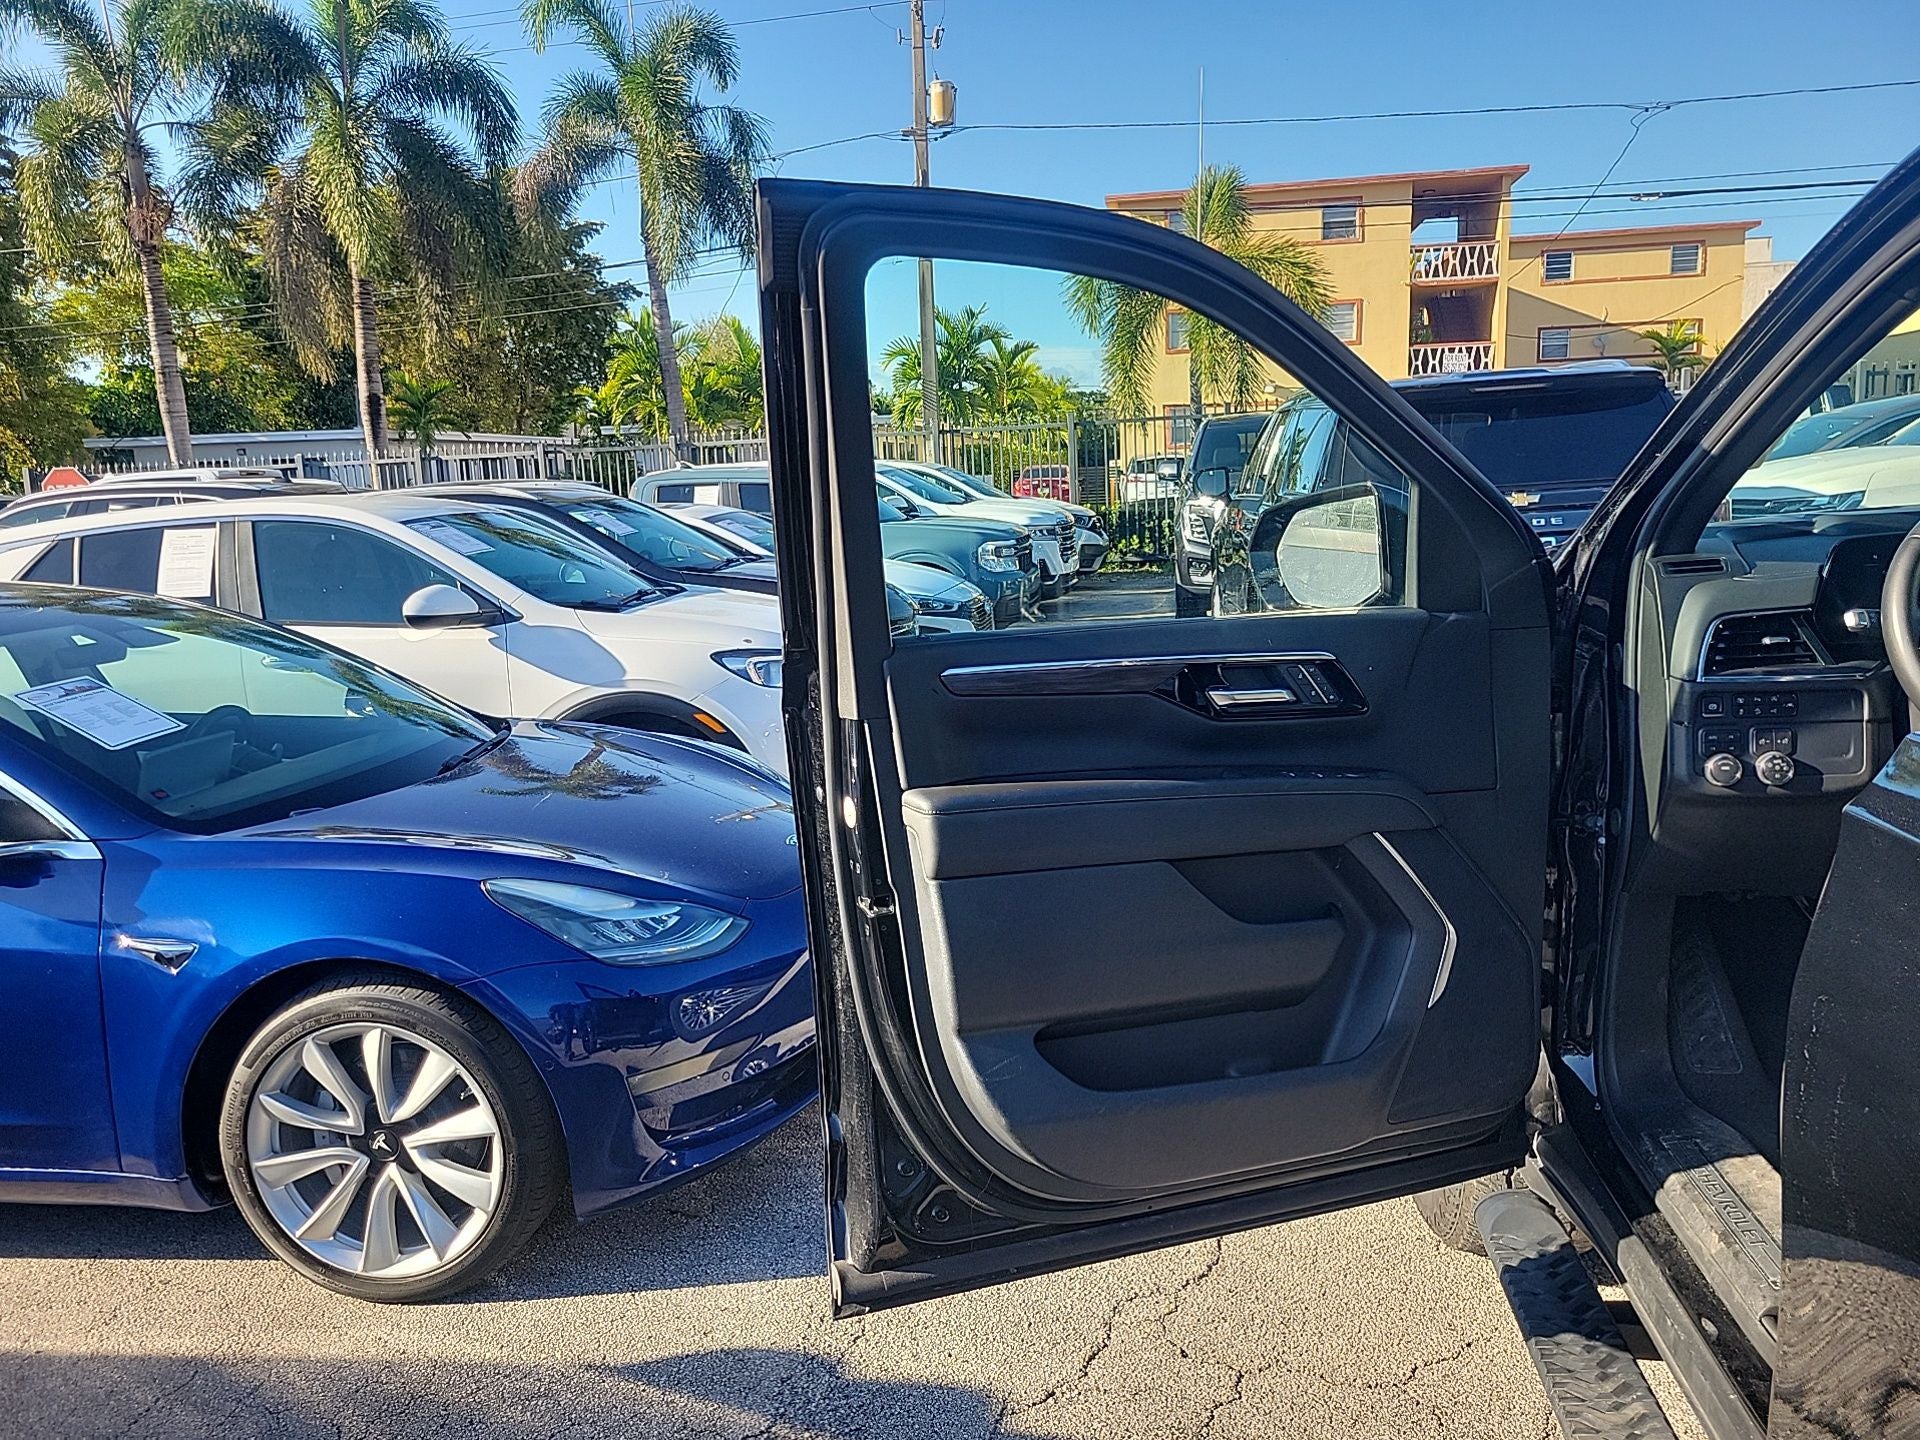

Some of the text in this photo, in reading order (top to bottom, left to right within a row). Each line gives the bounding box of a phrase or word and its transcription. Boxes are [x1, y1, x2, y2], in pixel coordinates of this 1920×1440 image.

[1444, 354, 1467, 362] FOR RENT
[1691, 1166, 1770, 1248] CHEVROLET
